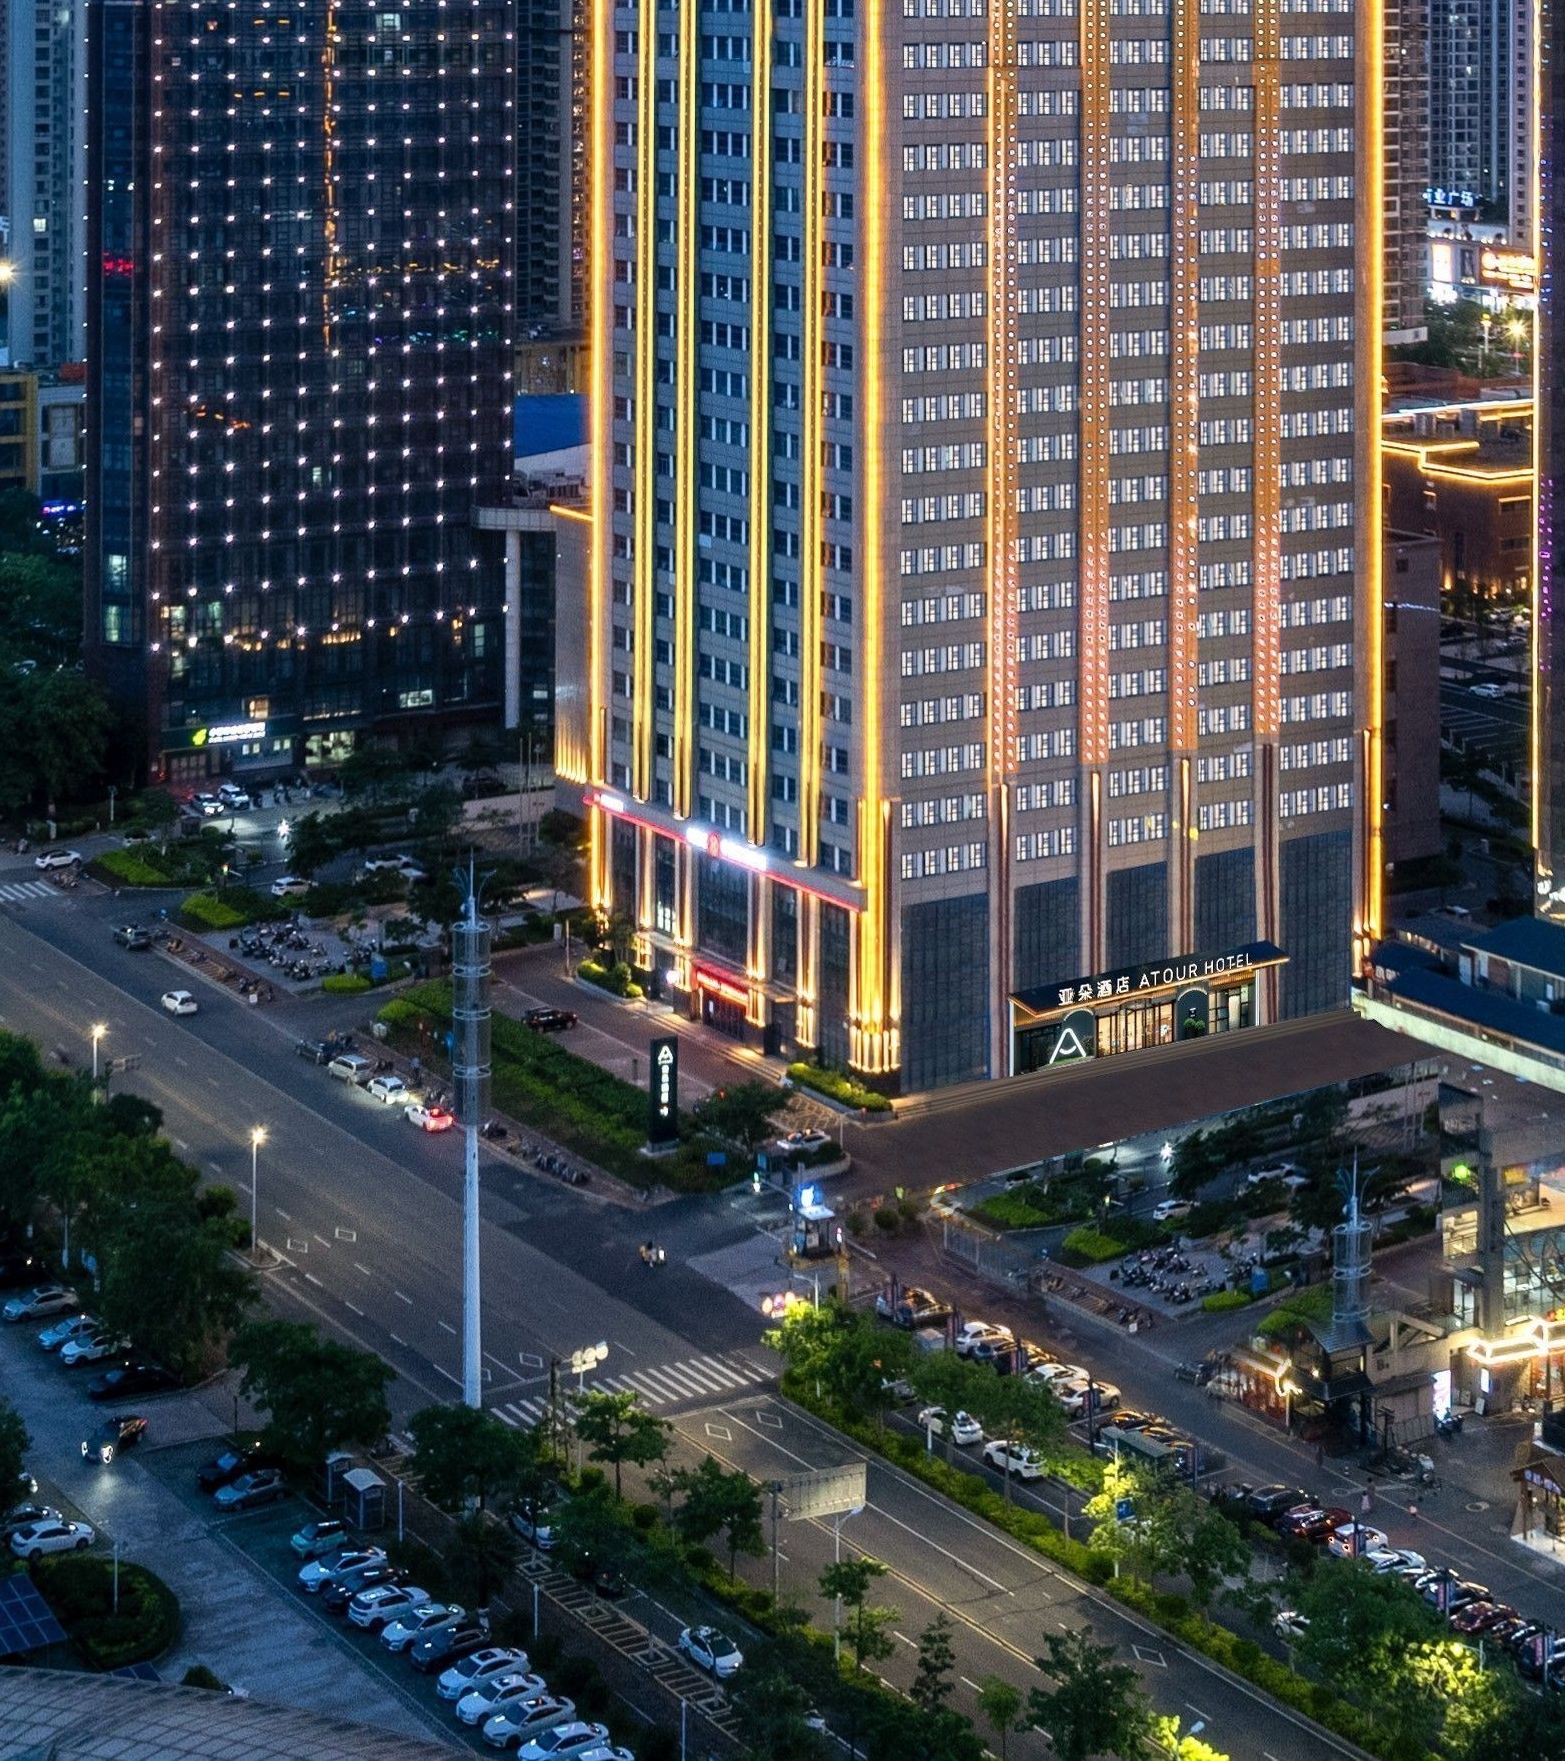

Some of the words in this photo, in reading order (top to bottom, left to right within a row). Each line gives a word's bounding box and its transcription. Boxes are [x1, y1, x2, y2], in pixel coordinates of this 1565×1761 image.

[1139, 963, 1198, 989] ATOUR
[1204, 953, 1253, 975] HOTEL
[1058, 976, 1130, 1007] 亚朵酒店
